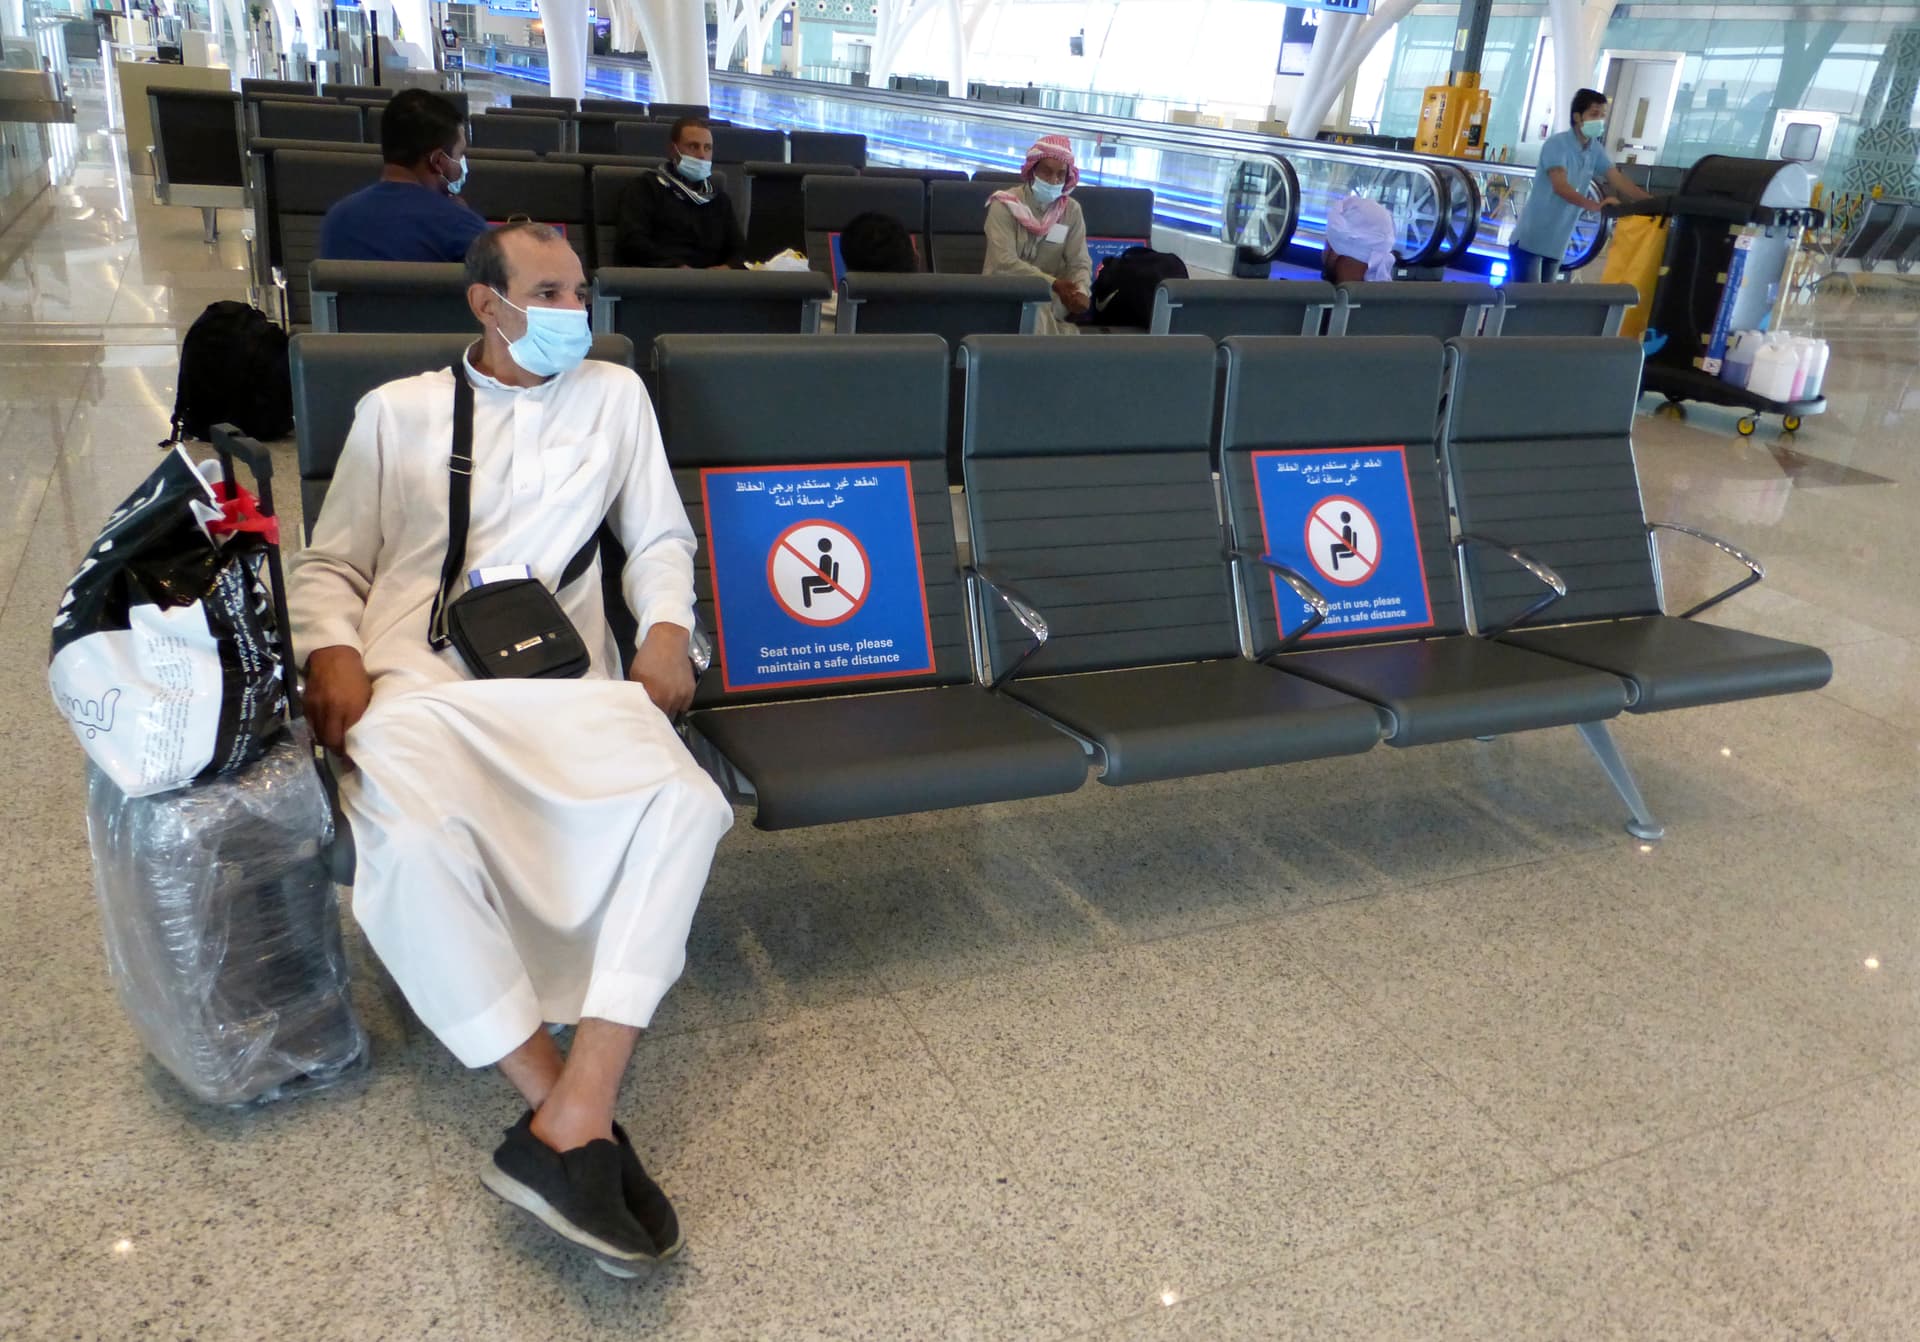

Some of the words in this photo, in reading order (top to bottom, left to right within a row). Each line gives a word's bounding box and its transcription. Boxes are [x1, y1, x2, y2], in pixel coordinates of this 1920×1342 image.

[736, 481, 766, 492] الحفاظ
[796, 480, 831, 493] مستخدم
[834, 477, 850, 490] غير
[853, 476, 879, 487] المقعد
[768, 482, 794, 495] يرجى
[797, 494, 825, 506] مسافة
[827, 494, 845, 508] على
[1328, 601, 1342, 611] not
[1343, 600, 1352, 609] in
[1353, 600, 1372, 609] use,
[1373, 597, 1402, 608] please
[1350, 611, 1369, 622] safe
[1370, 609, 1407, 620] distance
[760, 646, 789, 658] Seat
[791, 644, 812, 656] not
[814, 642, 826, 653] in
[829, 642, 854, 653] use,
[856, 638, 894, 652] please
[757, 659, 811, 674] maintain
[814, 660, 821, 670] a
[824, 656, 849, 668] safe
[851, 653, 900, 666] distance
